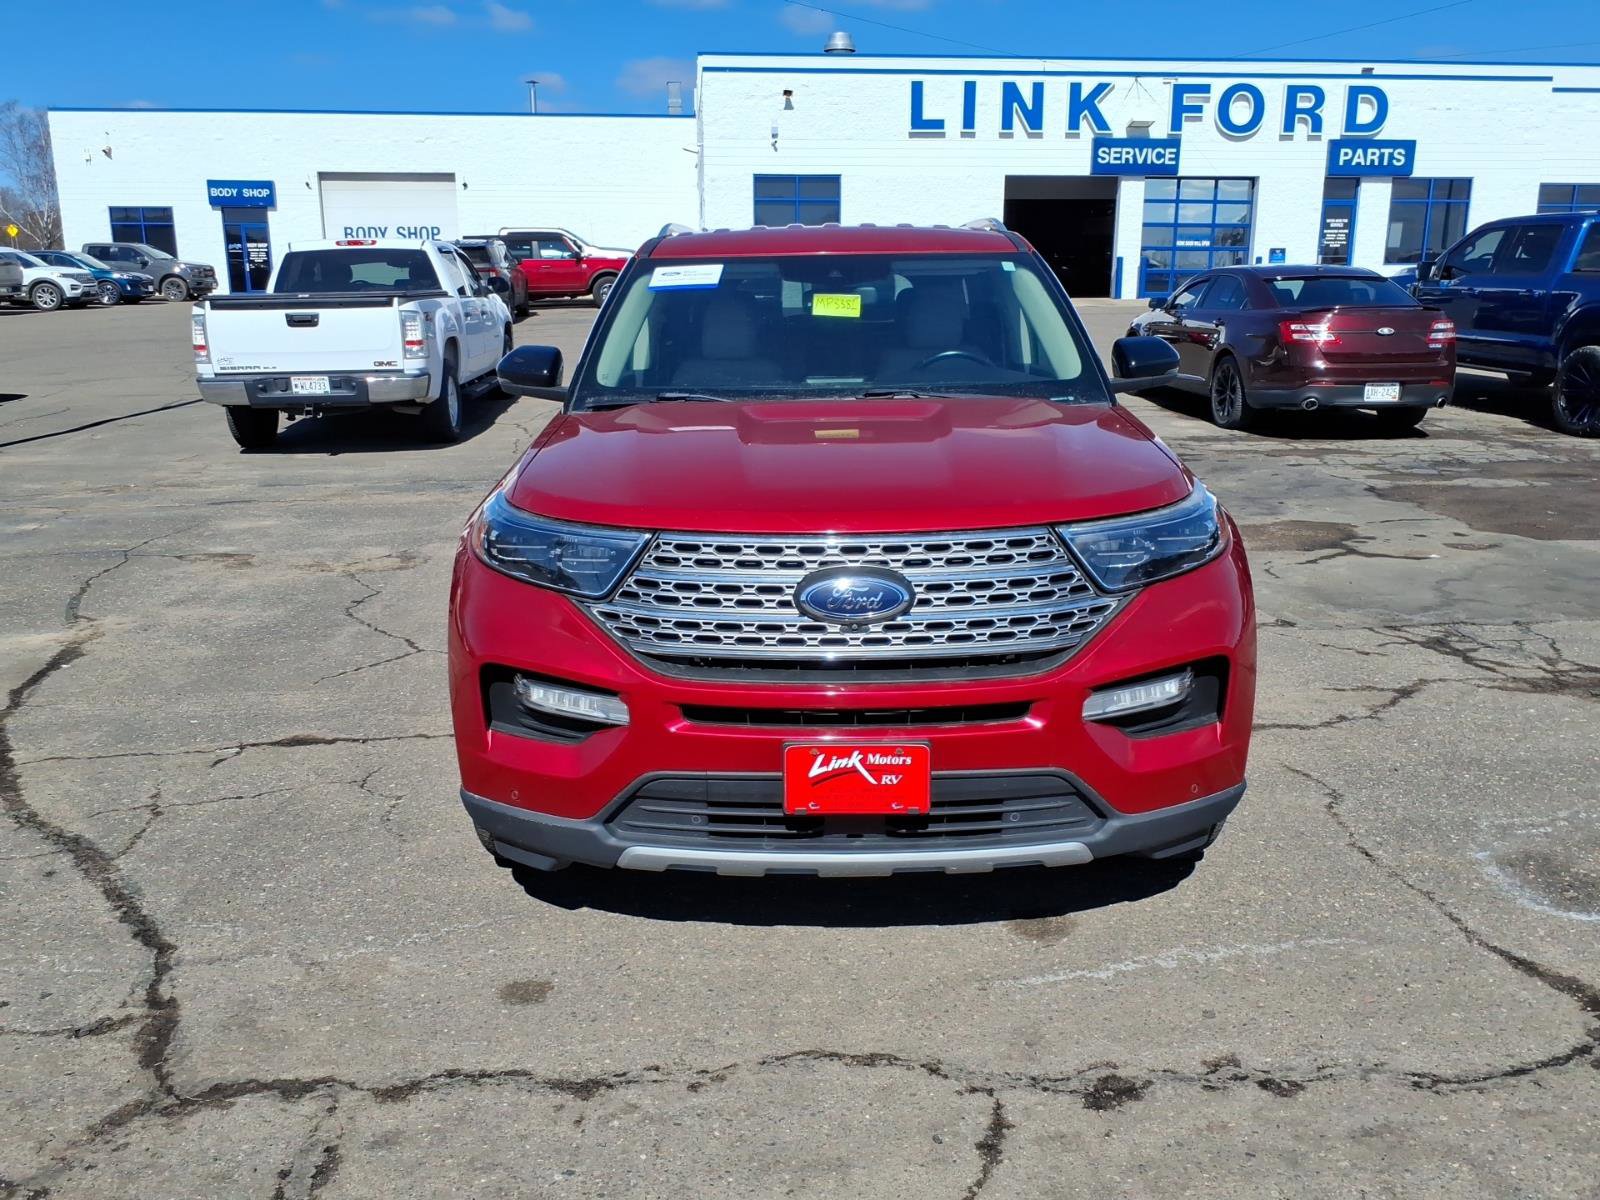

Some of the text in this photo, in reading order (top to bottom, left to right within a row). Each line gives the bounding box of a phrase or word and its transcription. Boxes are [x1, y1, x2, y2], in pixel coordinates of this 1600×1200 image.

[910, 80, 1389, 134] LINK FORD
[1097, 147, 1177, 165] SERVICE
[1338, 148, 1406, 166] PARTS
[210, 188, 270, 198] BODY SHOP
[343, 226, 441, 241] BODY SHOP
[827, 585, 883, 610] Ford
[808, 750, 912, 785] Link Motors
[880, 774, 903, 785] RV
